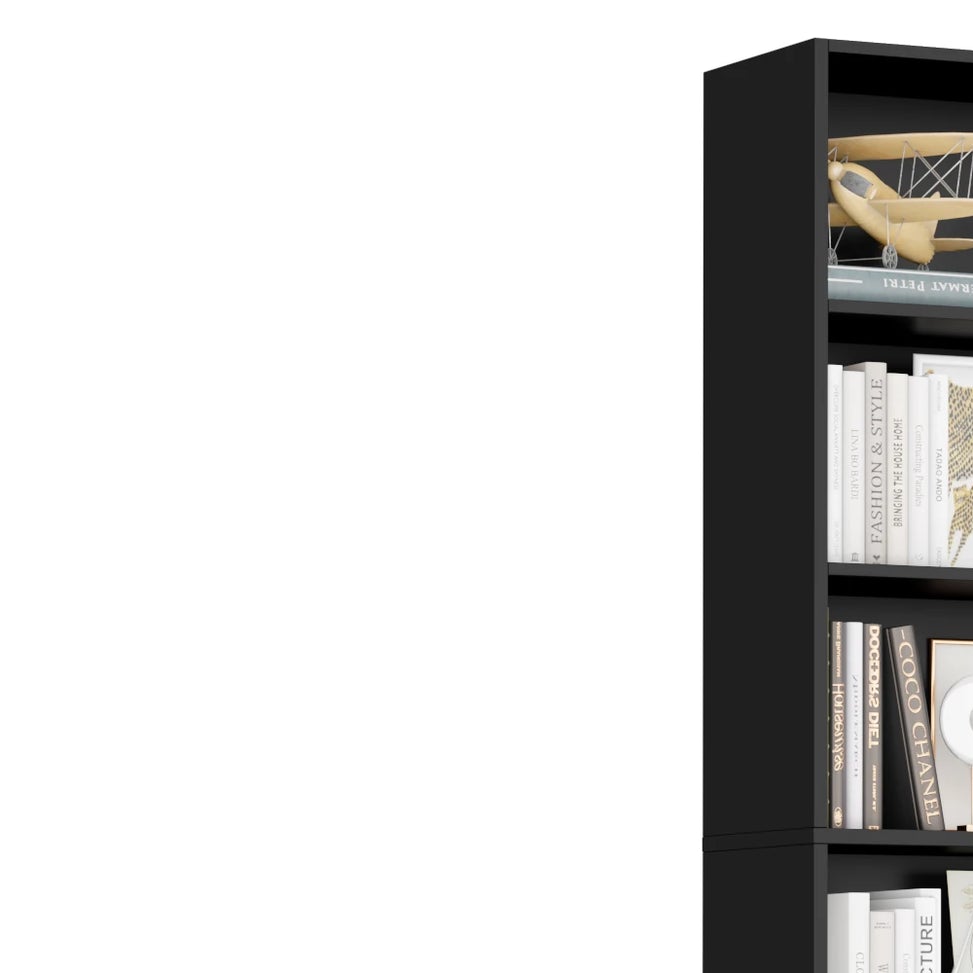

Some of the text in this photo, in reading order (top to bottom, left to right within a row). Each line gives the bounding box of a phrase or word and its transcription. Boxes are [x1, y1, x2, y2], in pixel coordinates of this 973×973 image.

[883, 277, 925, 292] PETRI
[851, 429, 859, 500] LINA BO BARDI
[871, 378, 882, 544] FASHION & STYLE
[893, 417, 903, 527] BRINGING THE HOUSE HOME
[912, 721, 940, 825] CHANEL
